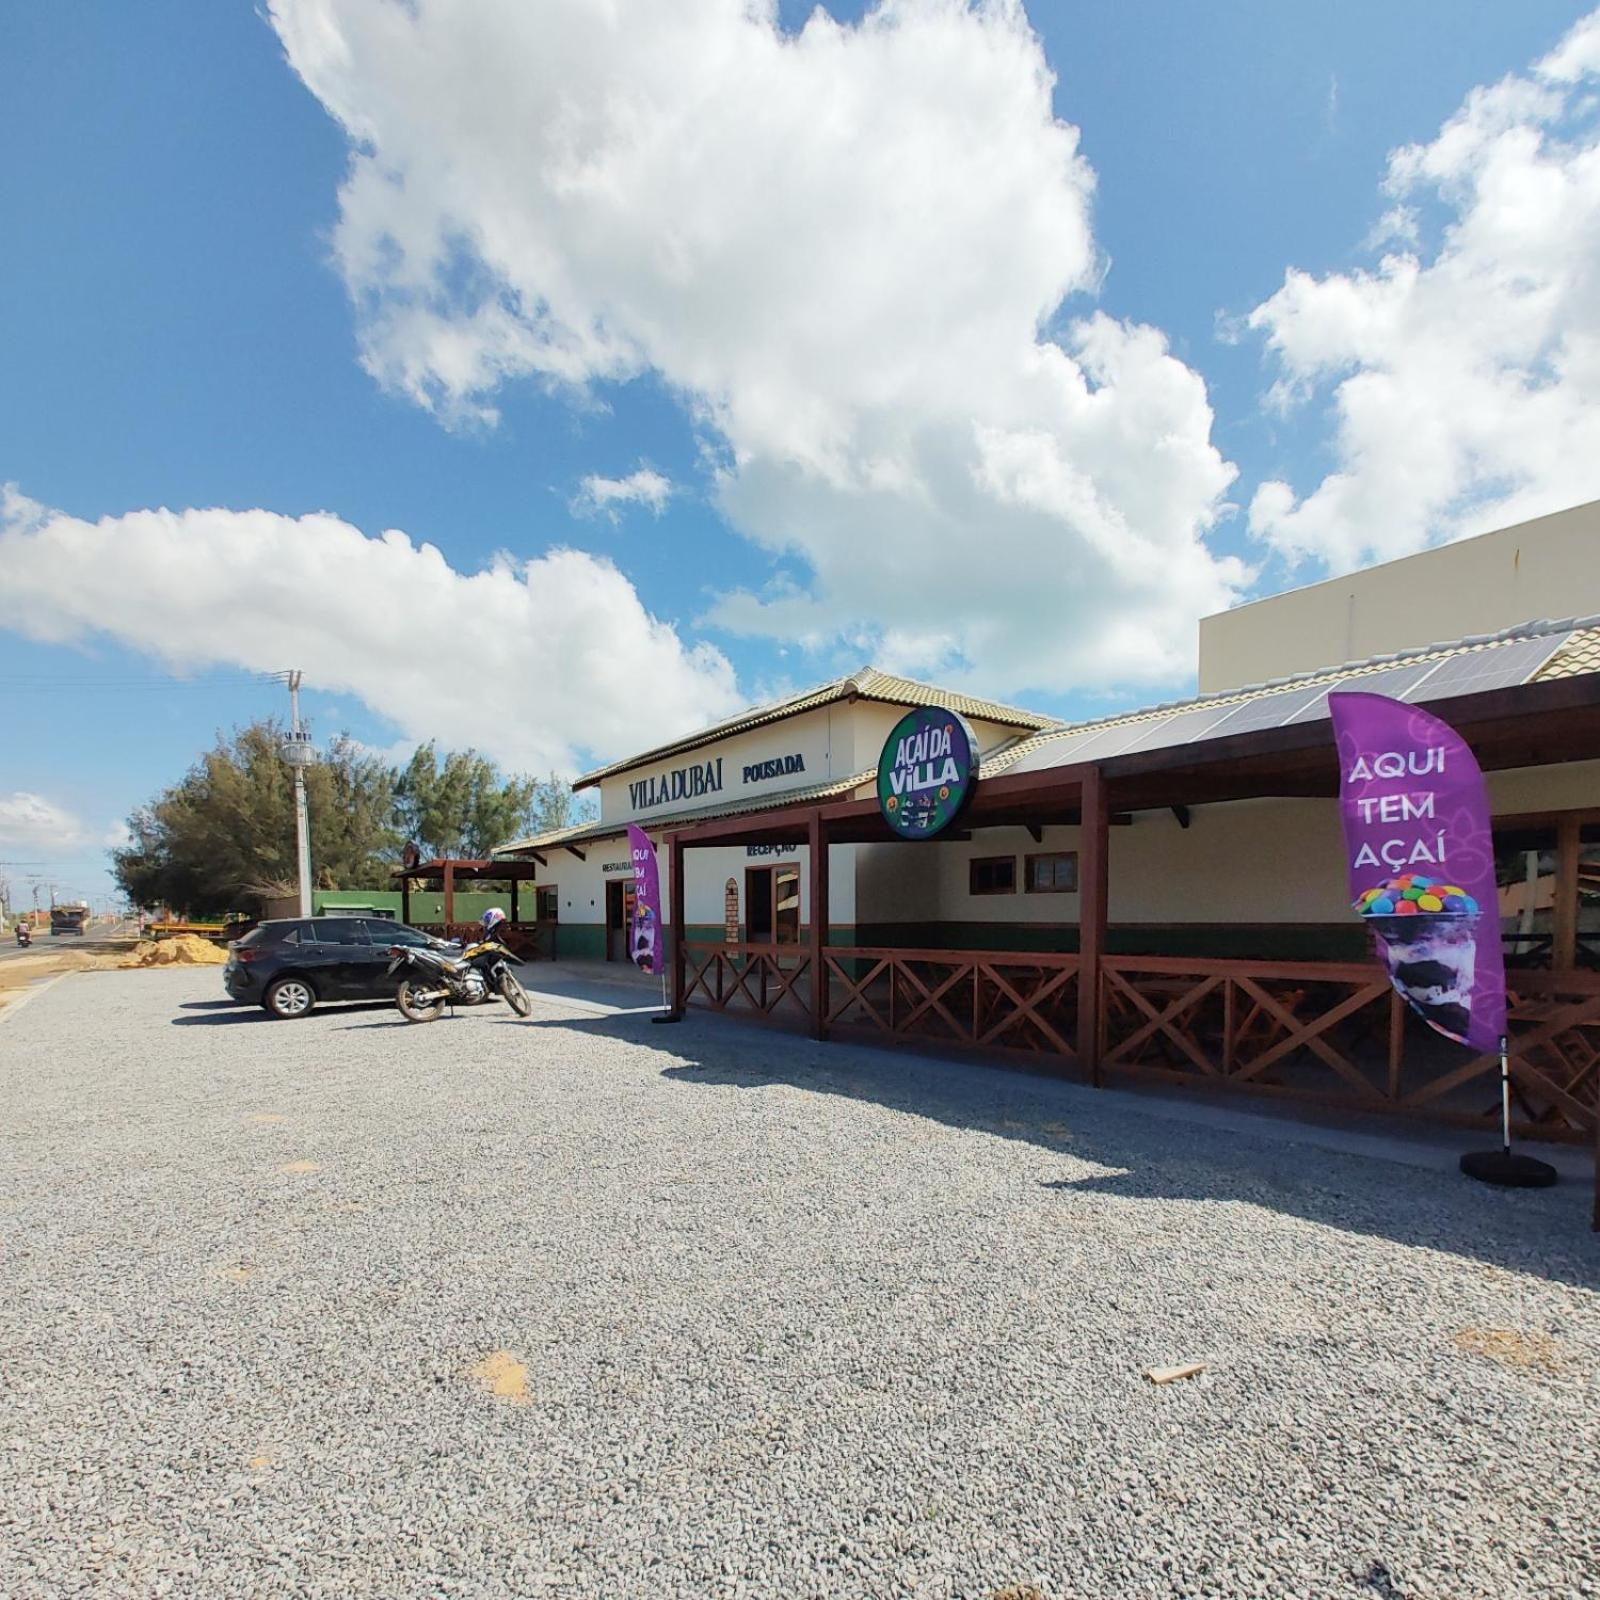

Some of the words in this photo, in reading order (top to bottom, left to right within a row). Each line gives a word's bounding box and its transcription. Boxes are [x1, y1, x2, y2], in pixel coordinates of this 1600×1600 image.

[895, 725, 930, 773] AÇAÍ
[930, 728, 951, 760] DA
[1348, 746, 1446, 784] AQUI
[741, 753, 806, 785] POUSADA
[1357, 791, 1435, 825] TEM
[1353, 829, 1447, 873] AÇAÍ
